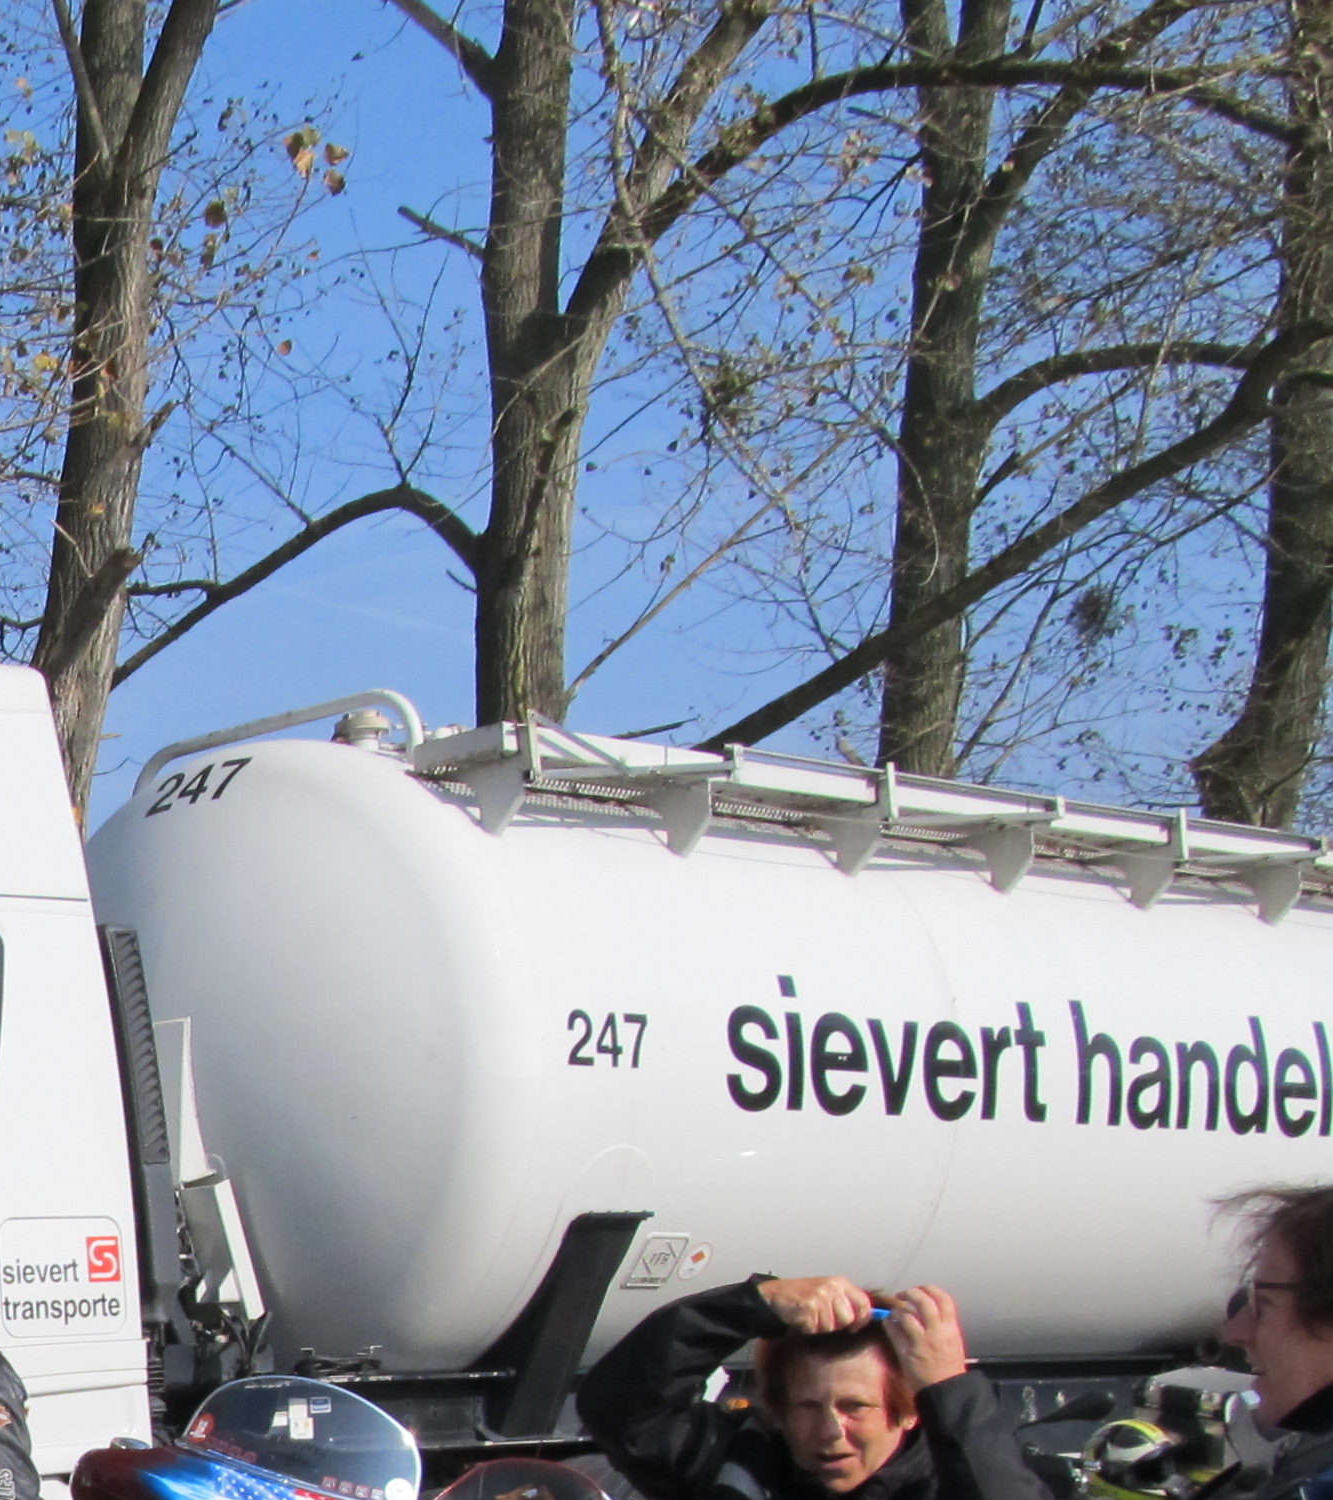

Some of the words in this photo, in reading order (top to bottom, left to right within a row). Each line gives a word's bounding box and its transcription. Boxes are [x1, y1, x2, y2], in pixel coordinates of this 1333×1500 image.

[144, 757, 253, 818] 247
[567, 1009, 648, 1068] 247
[726, 974, 1048, 1123] sievert
[1068, 999, 1332, 1138] handel
[2, 1258, 79, 1284] sievert
[2, 1293, 121, 1325] transporte
